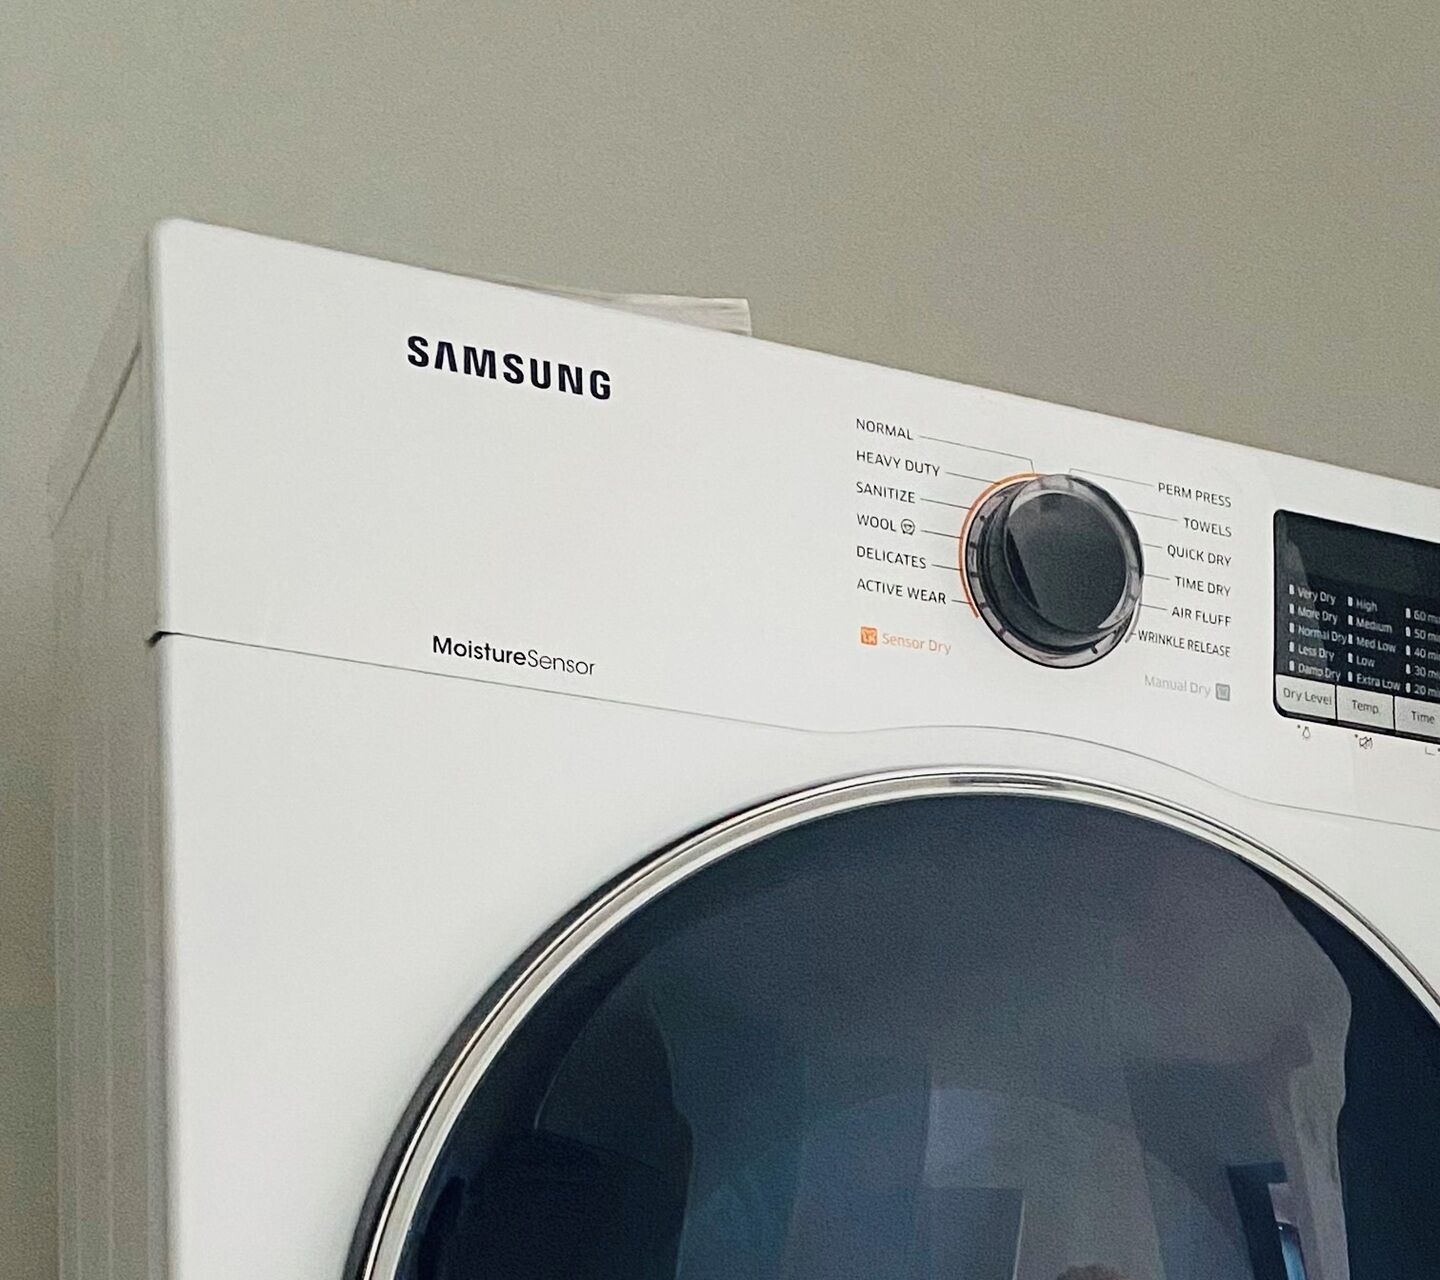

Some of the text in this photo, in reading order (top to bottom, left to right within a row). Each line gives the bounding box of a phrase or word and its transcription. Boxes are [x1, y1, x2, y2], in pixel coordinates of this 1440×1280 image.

[407, 335, 612, 400] SAMSUNG
[856, 418, 914, 440] NORMAL
[856, 449, 941, 478] HEAVY DUTY
[856, 482, 916, 504] SANITIZE
[1158, 481, 1232, 508] PERM PRESS
[857, 513, 897, 533] WOOL
[1183, 516, 1232, 538] TOWELS
[857, 545, 927, 570] DELICATES
[1167, 544, 1232, 568] QUICK DRY
[857, 577, 947, 606] ACTIVE WEAR
[1175, 575, 1232, 598] TIME DRY
[1320, 591, 1336, 606] Dry
[1172, 605, 1232, 628] AIR FLUFF
[1322, 611, 1338, 626] Dry
[881, 633, 951, 655] Sensor Dry
[1138, 629, 1231, 658] WRINKLE RELEASE
[1331, 631, 1347, 646] Dry
[1378, 640, 1397, 653] Low
[432, 635, 596, 675] MoistureSensor
[1319, 648, 1335, 662] Dry
[1356, 655, 1375, 668] Low
[1325, 667, 1341, 682] Dry
[1382, 677, 1401, 691] Low
[1144, 674, 1211, 698] Manual Dry
[1283, 687, 1332, 705] Dry Level
[1411, 711, 1435, 725] Time
